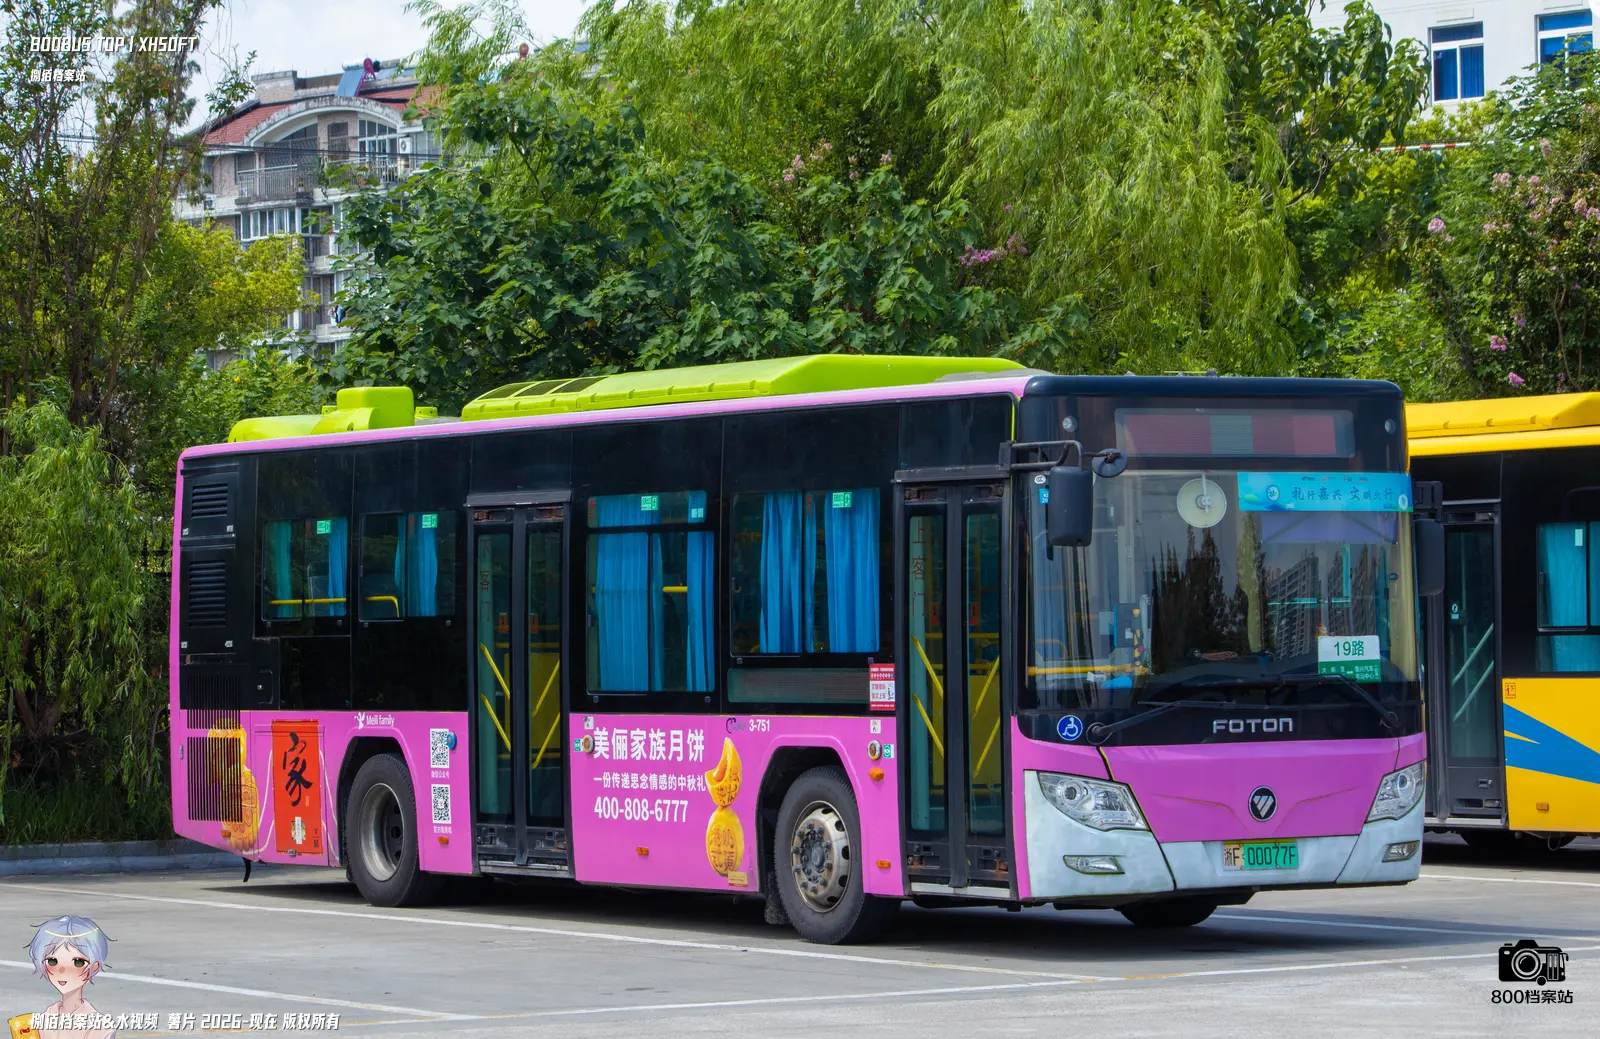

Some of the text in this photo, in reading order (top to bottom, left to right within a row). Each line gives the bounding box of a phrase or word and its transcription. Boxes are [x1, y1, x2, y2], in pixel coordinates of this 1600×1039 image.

[1334, 640, 1365, 657] 19路
[749, 719, 770, 732] 3-751
[1212, 717, 1293, 734] FOTON
[593, 727, 705, 762] 美俪家族月饼
[593, 772, 706, 792] 一份传递思念情感的中秋礼
[594, 796, 688, 823] 400-808-6777
[1247, 845, 1296, 866] 00077F
